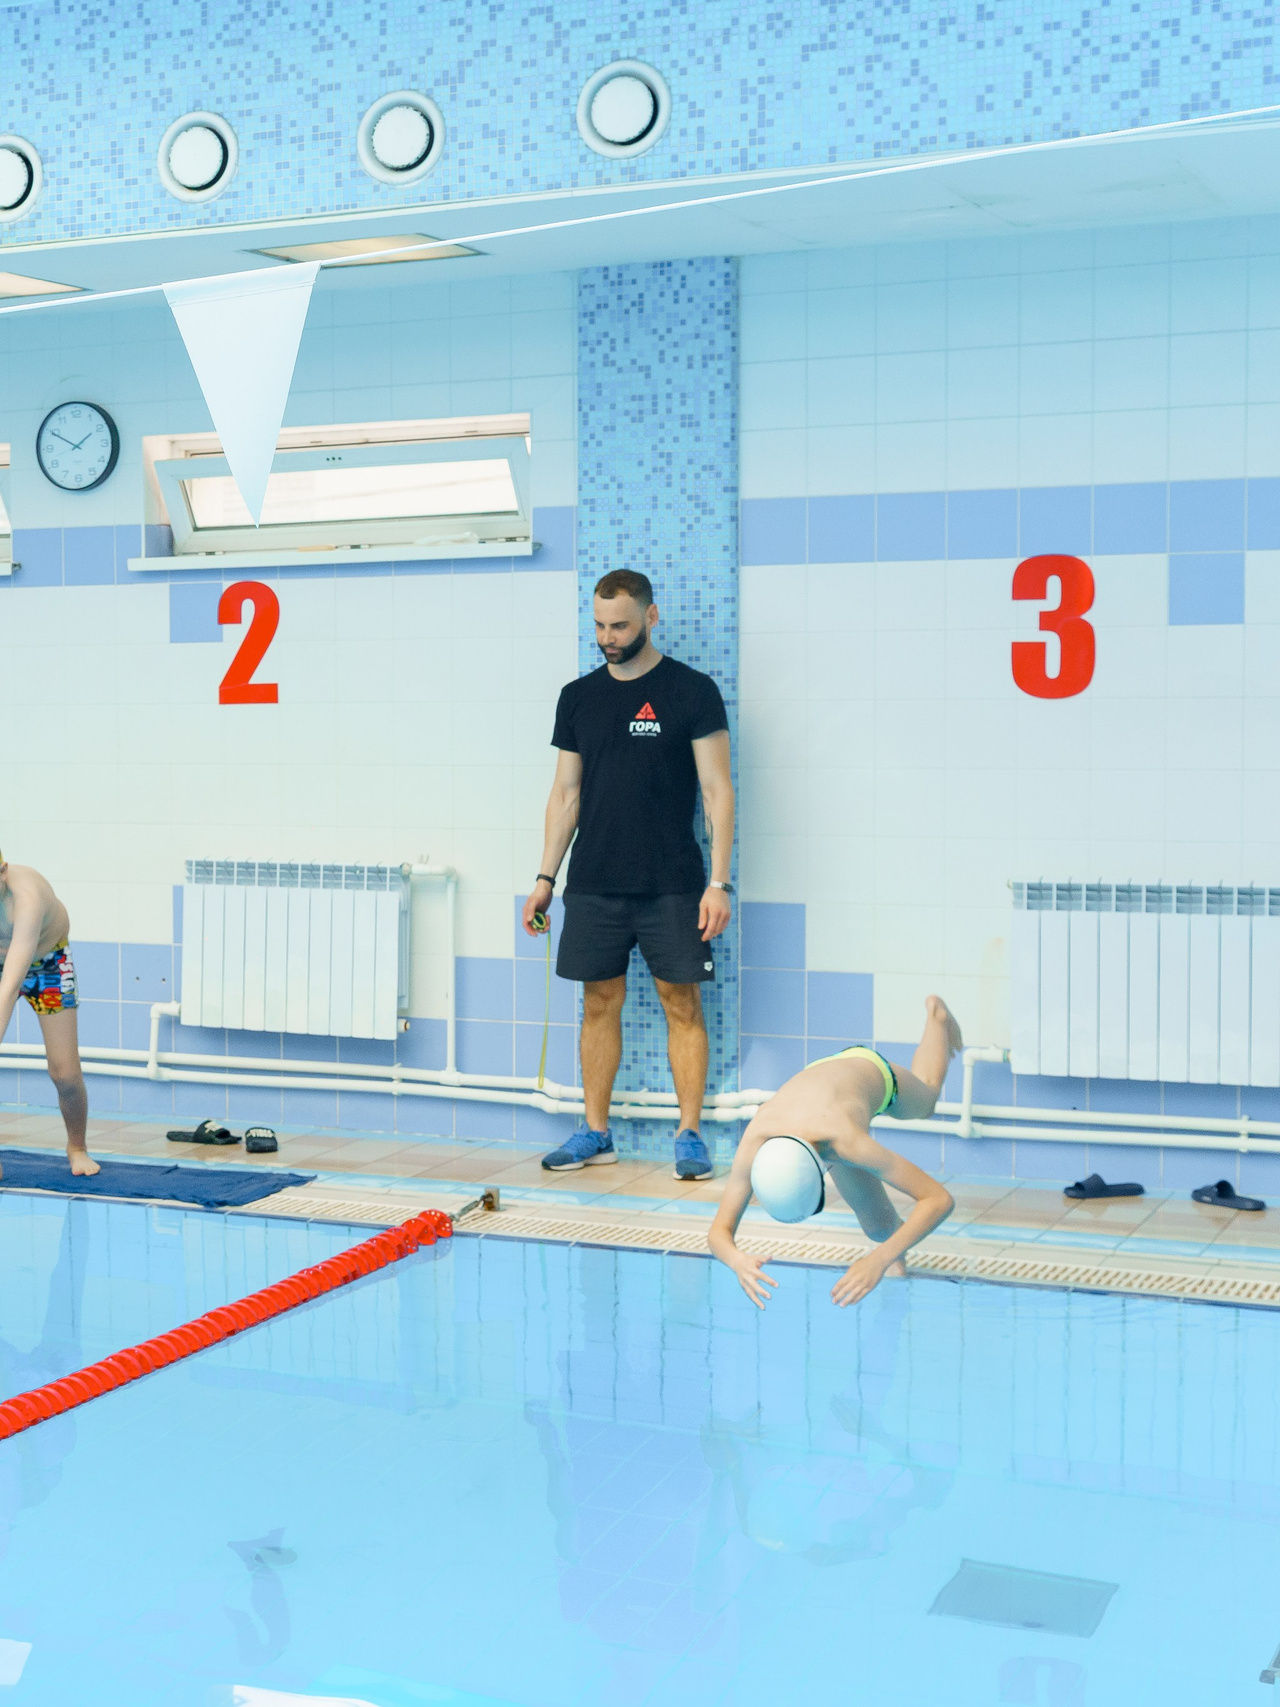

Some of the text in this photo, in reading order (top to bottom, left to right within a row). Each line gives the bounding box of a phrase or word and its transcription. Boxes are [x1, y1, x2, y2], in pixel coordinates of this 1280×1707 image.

[70, 409, 82, 419] 12
[96, 423, 104, 433] 2
[101, 439, 109, 448] 3
[46, 444, 54, 453] 9
[51, 460, 59, 468] 8
[62, 470, 69, 479] 7
[88, 467, 97, 476] 5
[75, 474, 83, 483] 6
[1011, 554, 1096, 699] 3
[217, 581, 280, 705] 2
[629, 721, 661, 733] ГОРА
